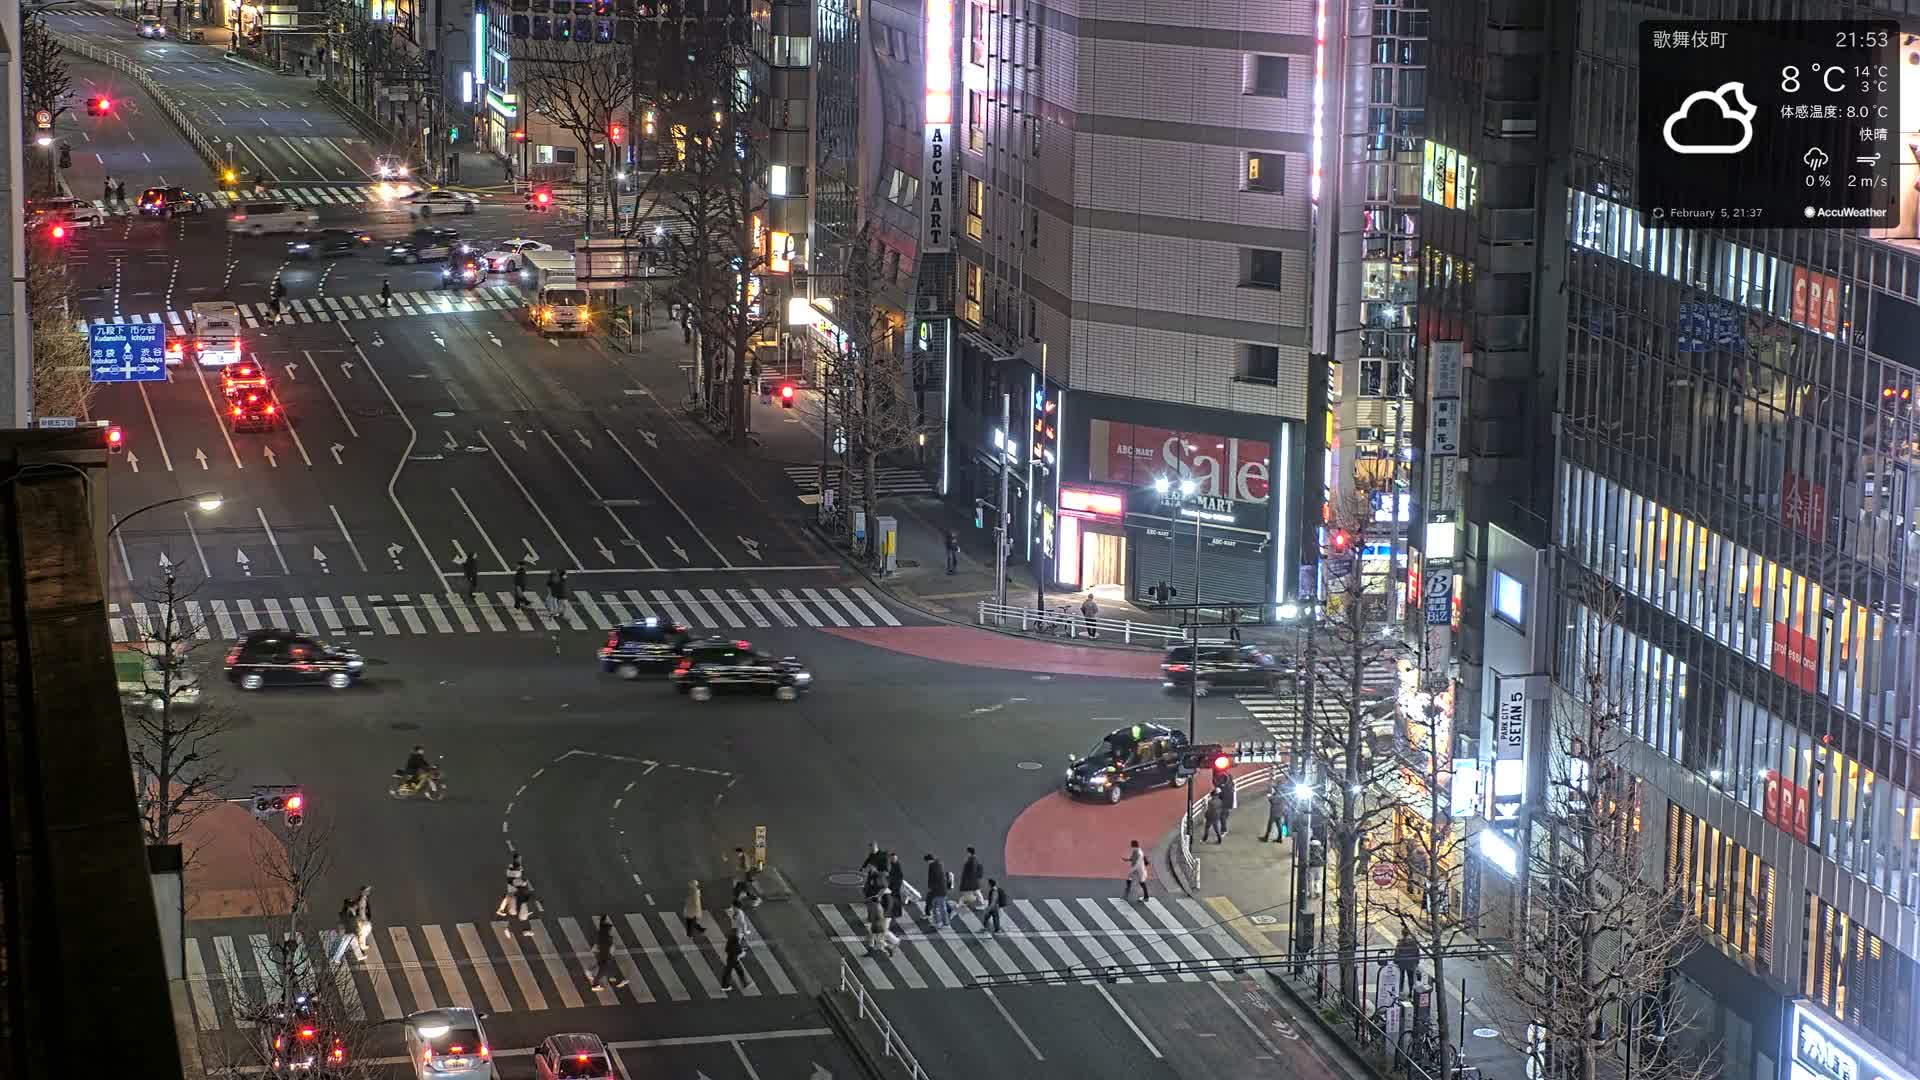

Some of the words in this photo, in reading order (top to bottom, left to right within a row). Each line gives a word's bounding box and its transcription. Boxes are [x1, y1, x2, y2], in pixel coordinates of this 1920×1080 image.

[1795, 277, 1836, 321] CPA
[97, 325, 125, 335] 九段下
[131, 335, 156, 343] Ichigaya
[1162, 436, 1269, 504] Sale
[1510, 692, 1523, 702] 5
[1501, 702, 1509, 720] CITY
[1500, 721, 1509, 740] PARK
[1509, 705, 1522, 746] ISETAN
[1767, 780, 1806, 830] CPA
